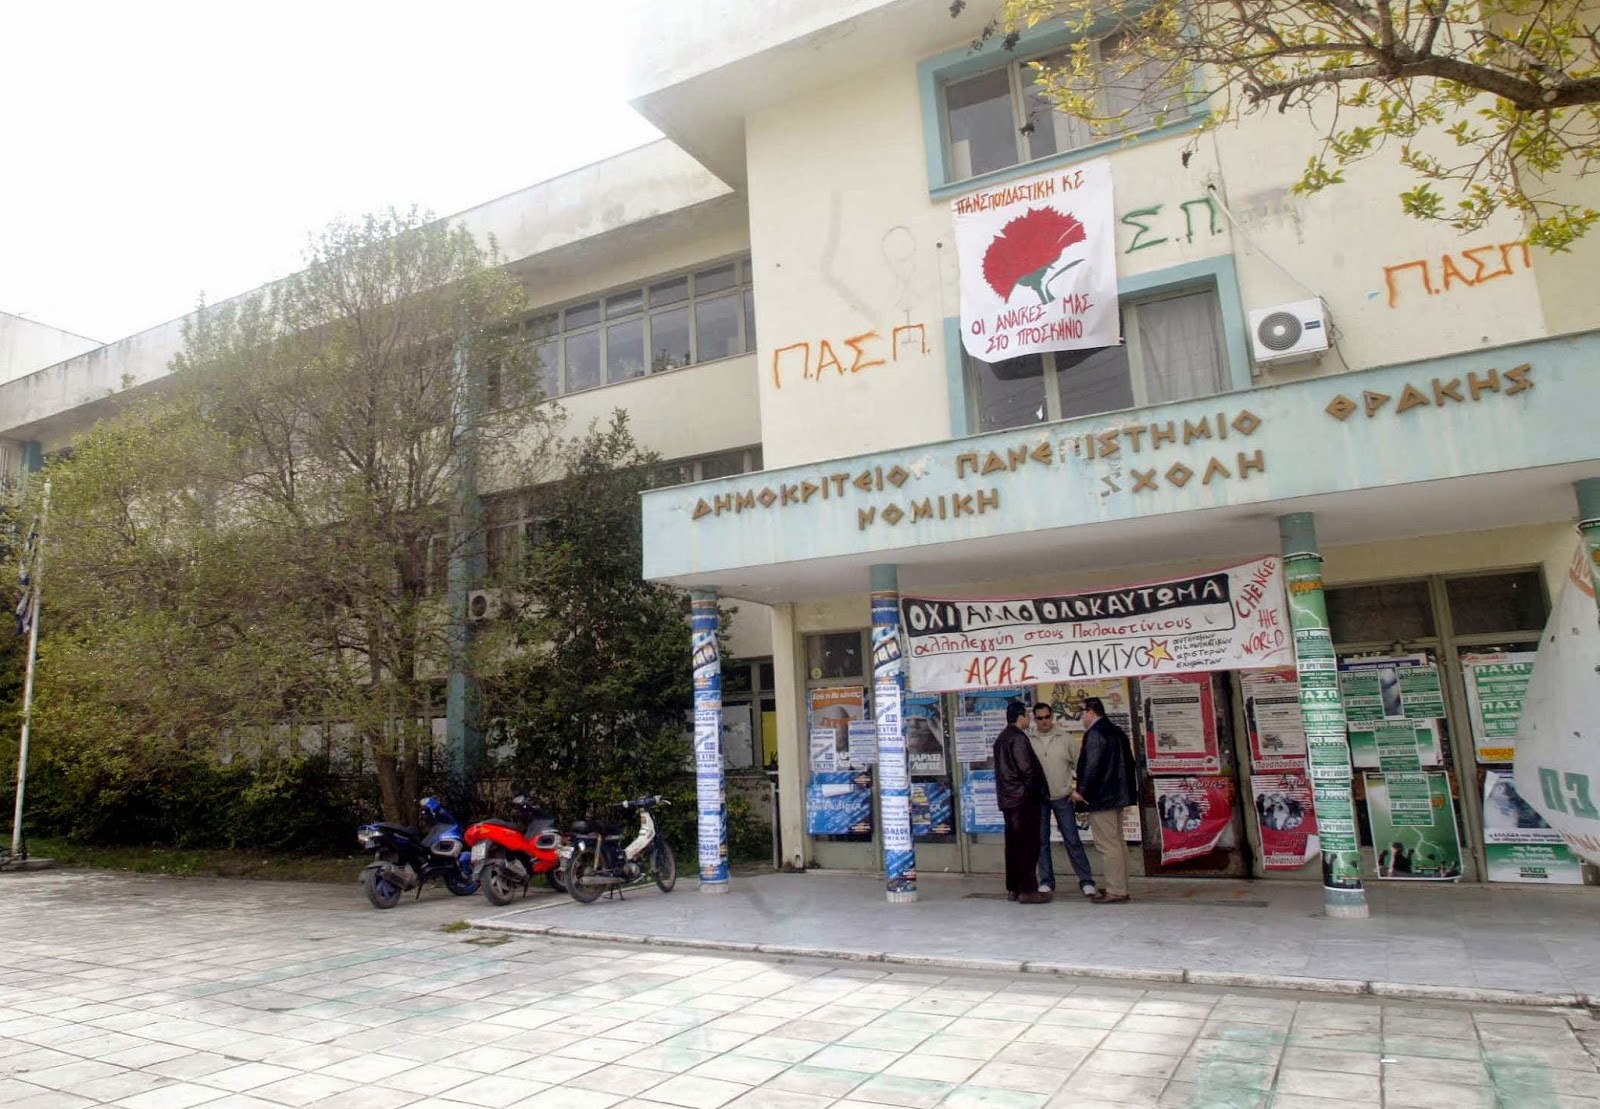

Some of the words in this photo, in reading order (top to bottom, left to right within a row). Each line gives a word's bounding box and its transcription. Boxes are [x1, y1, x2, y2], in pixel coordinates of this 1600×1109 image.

[971, 318, 985, 336] ΟΙ
[996, 303, 1047, 331] ΑΝΑΓΚΕΣ
[1063, 293, 1094, 315] ΜΑΣ
[986, 335, 1009, 354] ΣΤΟ
[1017, 317, 1083, 346] ΠΡΟΣΚΗΝΙΟ
[691, 465, 910, 520] ΔΗΜΟΚΡΙΤΕΙΟ
[956, 409, 1262, 479] ΠΑΝΕΠΙΣΤΗΜΙΟ
[1324, 363, 1536, 422] ΘΡΑΚΗΣ
[858, 488, 999, 530] ΝΟΜΙΚΗ
[1100, 448, 1265, 498] ΣΧΟΛΗ
[909, 602, 955, 631] ΟΧΙ
[967, 604, 1033, 625] ΑΛΛΟ
[1024, 627, 1063, 641] στους
[1072, 617, 1192, 639] Παλαιστίνιους
[1258, 608, 1279, 629] THE
[1242, 629, 1284, 655] WORLD
[1474, 663, 1526, 675] ΠΑΣΠ
[1481, 700, 1519, 710] ΠΑΣ
